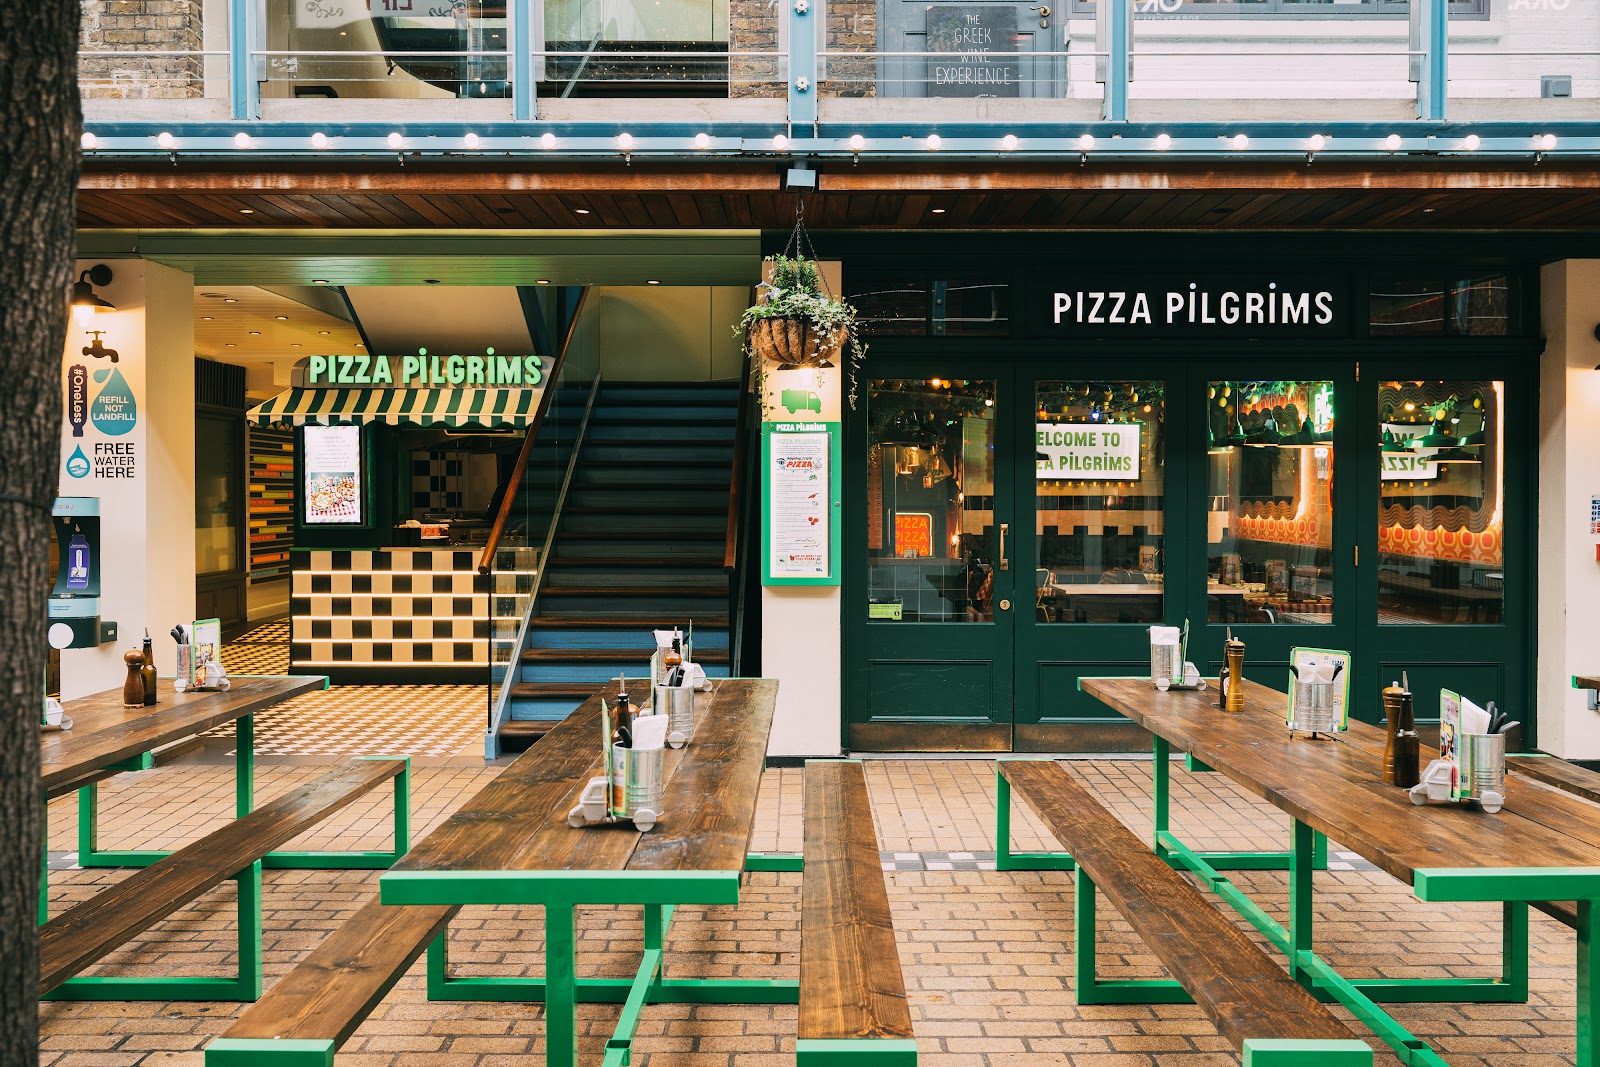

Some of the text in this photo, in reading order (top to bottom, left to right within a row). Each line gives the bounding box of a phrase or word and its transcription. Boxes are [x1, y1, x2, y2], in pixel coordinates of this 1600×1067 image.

[966, 15, 980, 25] THE
[954, 28, 991, 43] GREEK
[959, 48, 990, 62] WINE
[936, 67, 1010, 84] EXPERIENCE
[1054, 291, 1151, 324] PIZZA
[309, 355, 393, 384] PIZZA
[73, 368, 83, 423] #OneLess
[99, 396, 129, 404] REFILL
[104, 404, 123, 412] NOT
[93, 413, 135, 421] LANDFILL
[1036, 431, 1121, 447] ELCOME TO
[94, 443, 135, 455] FREE
[94, 456, 135, 466] WATER
[95, 467, 135, 478] HERE
